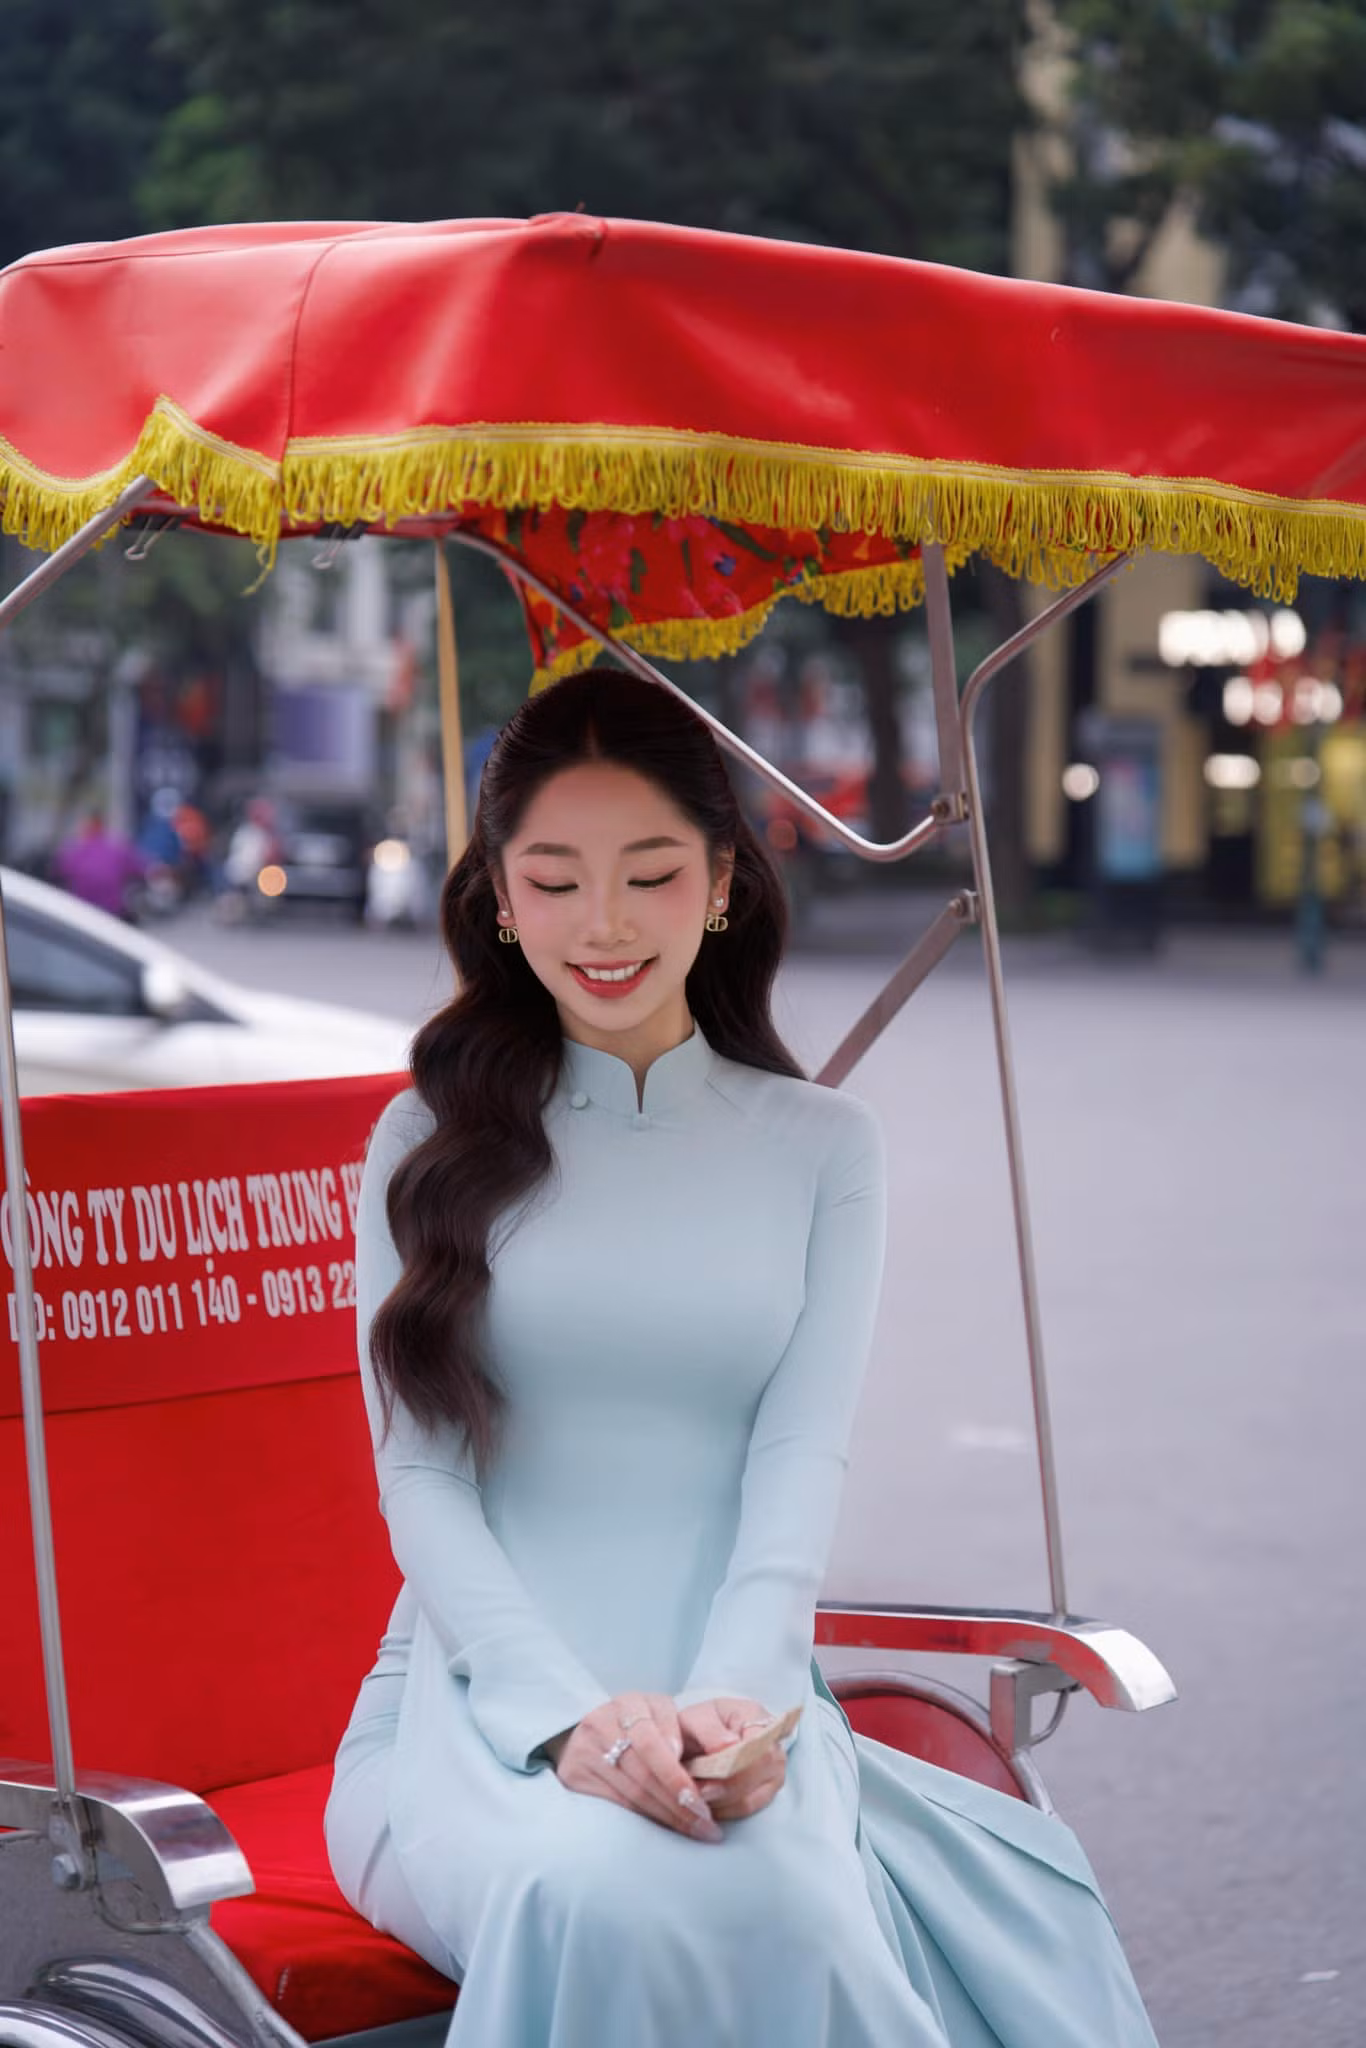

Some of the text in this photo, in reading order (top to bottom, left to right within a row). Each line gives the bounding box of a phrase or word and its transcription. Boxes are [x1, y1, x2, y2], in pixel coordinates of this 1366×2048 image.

[87, 1186, 129, 1266] TY
[131, 1183, 177, 1262] DU
[177, 1176, 250, 1274] LỊCH
[246, 1164, 344, 1248] TRUNG
[62, 1287, 131, 1341] 0912
[135, 1282, 184, 1334] 011
[191, 1273, 242, 1326] 140
[261, 1265, 326, 1319] 0913
